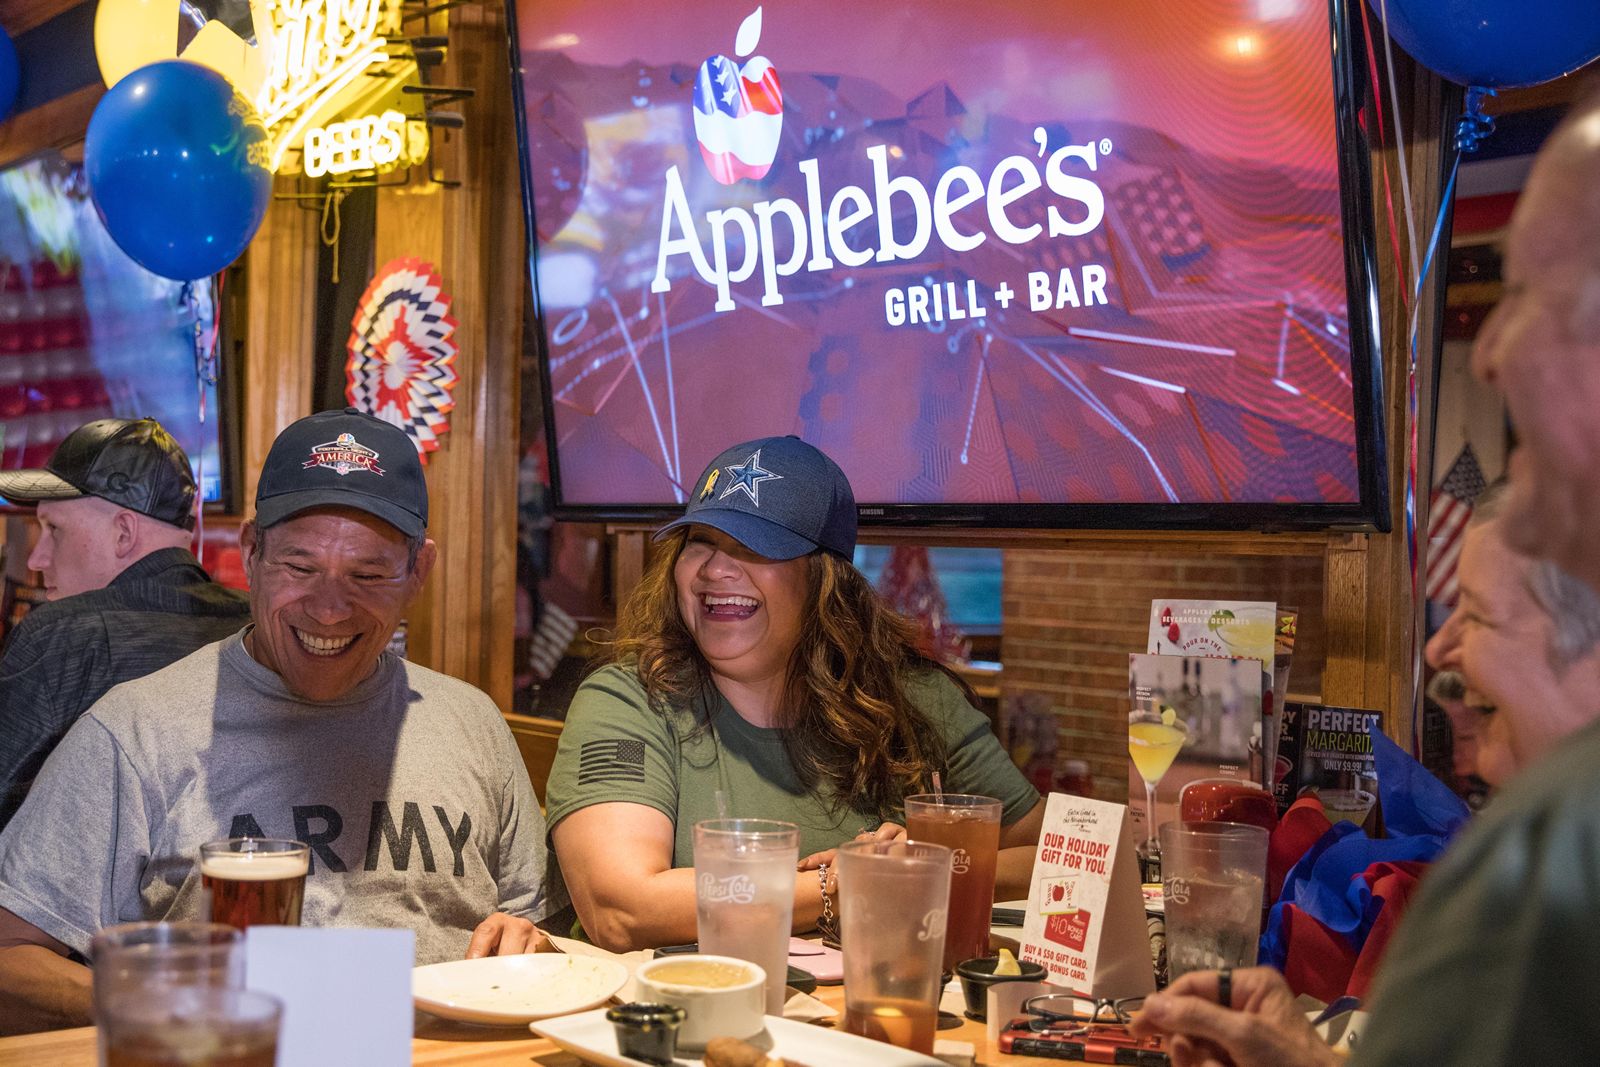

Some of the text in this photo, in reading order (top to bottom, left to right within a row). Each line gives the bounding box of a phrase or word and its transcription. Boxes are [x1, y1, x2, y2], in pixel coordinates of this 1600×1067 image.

[304, 110, 407, 178] BEERS
[885, 278, 986, 327] GRILL
[1027, 264, 1109, 312] BAR
[318, 451, 371, 468] AMERICA
[1162, 616, 1202, 624] BEVERAGES
[1183, 638, 1198, 651] POUR
[1210, 640, 1222, 652] THE
[1324, 760, 1342, 770] ONLY
[1044, 832, 1110, 858] OUR HOLIDAY
[1041, 848, 1106, 875] GIFT FOR YOU.
[1051, 914, 1068, 935] $10
[1024, 944, 1036, 955] BUY
[1037, 947, 1042, 957] A
[1056, 952, 1069, 964] GIFT
[1071, 956, 1088, 970] CARD.
[1050, 962, 1069, 976] BONUS
[1071, 969, 1087, 982] CARD.
